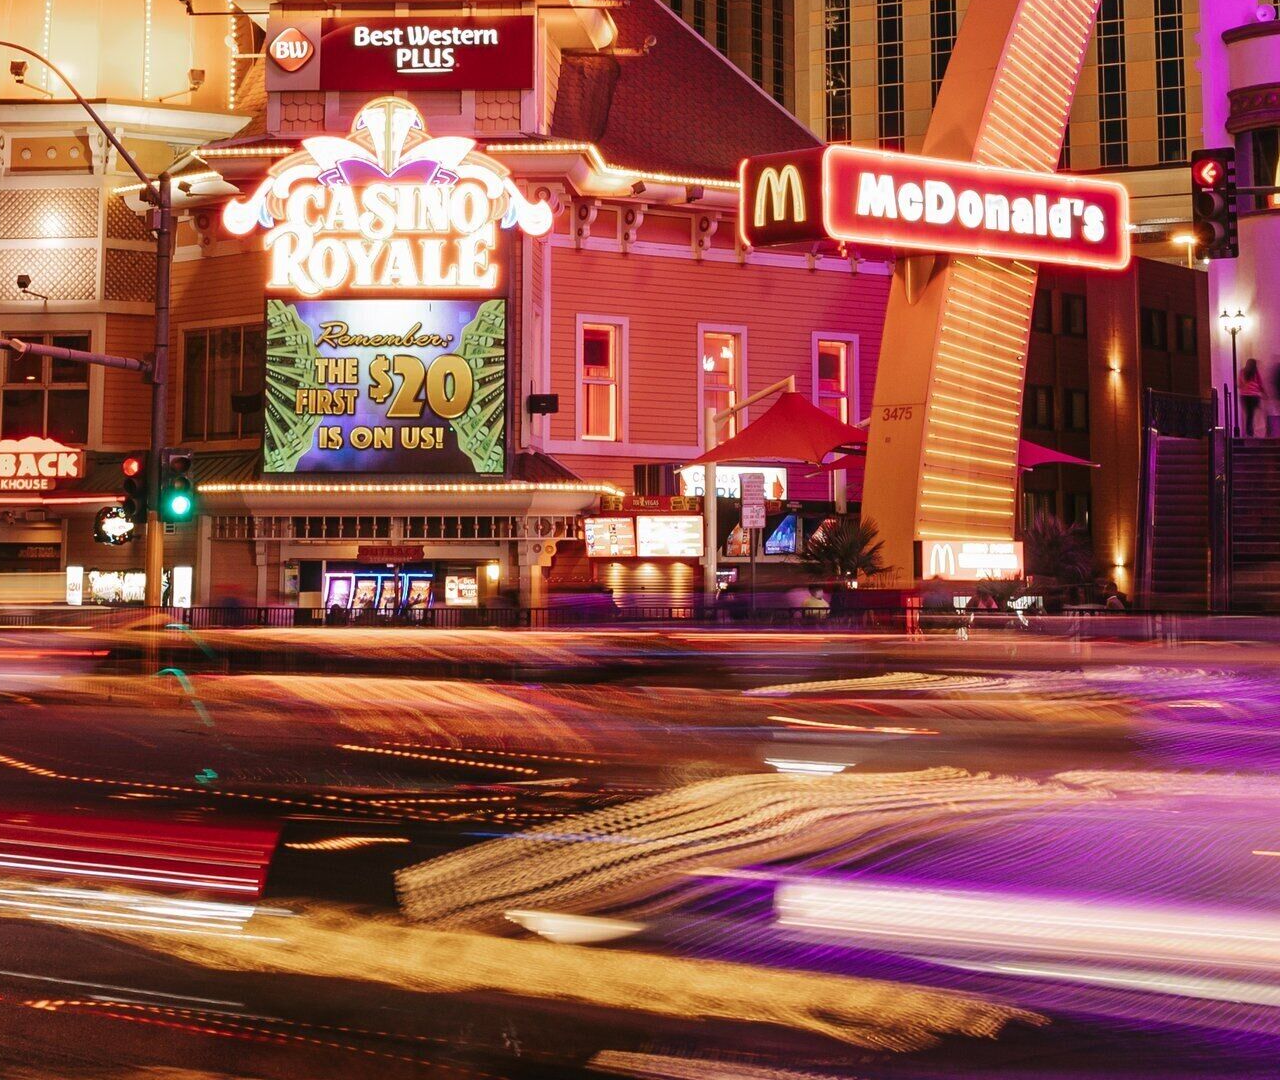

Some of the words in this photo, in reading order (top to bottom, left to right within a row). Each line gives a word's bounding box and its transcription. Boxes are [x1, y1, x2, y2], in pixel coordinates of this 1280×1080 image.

[275, 40, 308, 60] BW
[353, 25, 404, 47] Best
[406, 27, 499, 46] Western
[395, 47, 455, 69] PLUS
[285, 183, 491, 241] CASINO
[857, 171, 1107, 243] McDonald's
[264, 220, 499, 298] ROYALE
[315, 320, 454, 348] Remember:
[315, 356, 359, 385] THE
[369, 354, 474, 419] $20
[295, 388, 360, 416] FIRST
[882, 406, 913, 422] 3475
[319, 426, 344, 449] IS
[350, 426, 393, 449] ON
[400, 426, 445, 449] US!
